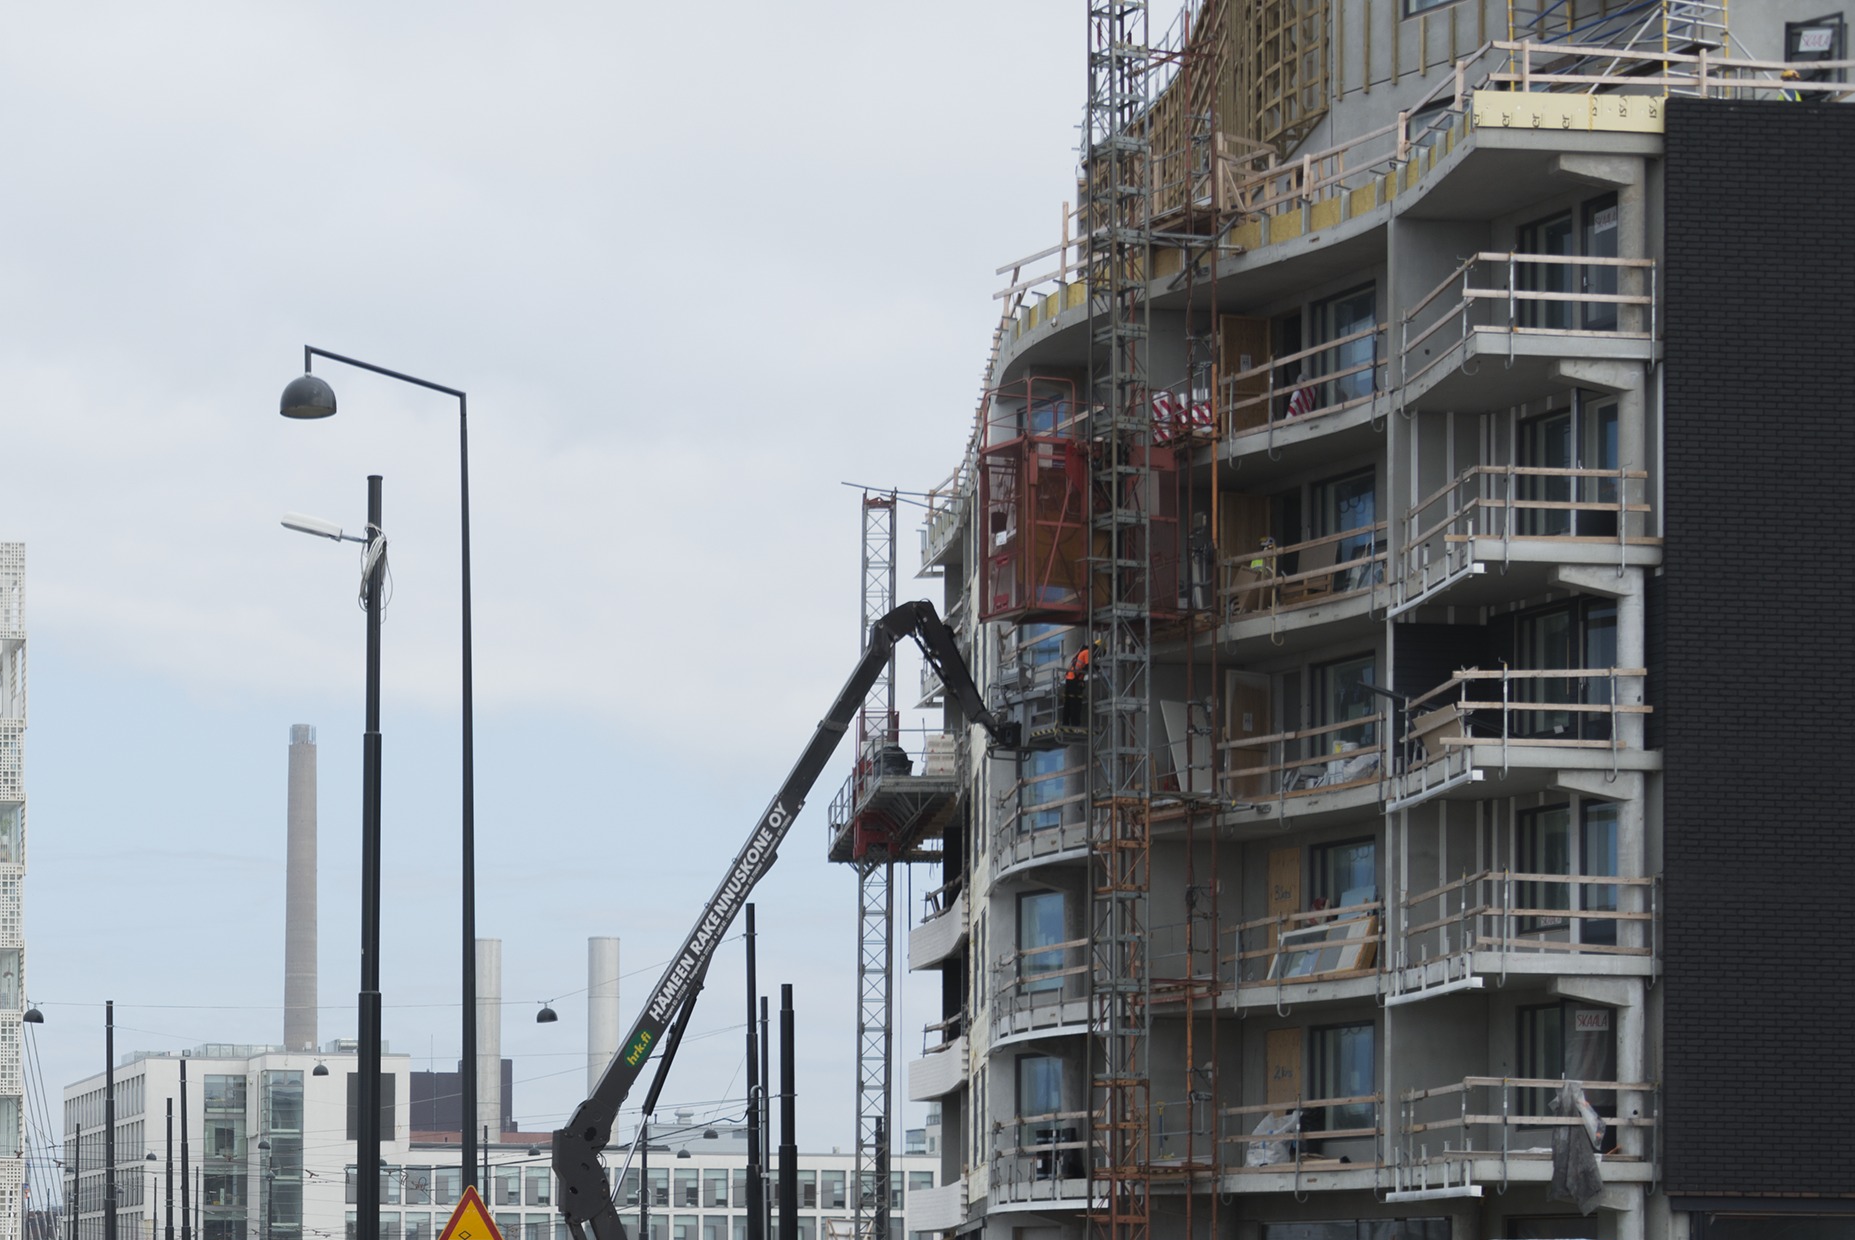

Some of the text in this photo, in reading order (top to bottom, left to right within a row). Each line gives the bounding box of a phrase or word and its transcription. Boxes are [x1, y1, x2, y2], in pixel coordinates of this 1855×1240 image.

[648, 801, 788, 1022] HÄMEEN RAKENNUSKONE OY
[627, 1031, 652, 1066] hrk.fi
